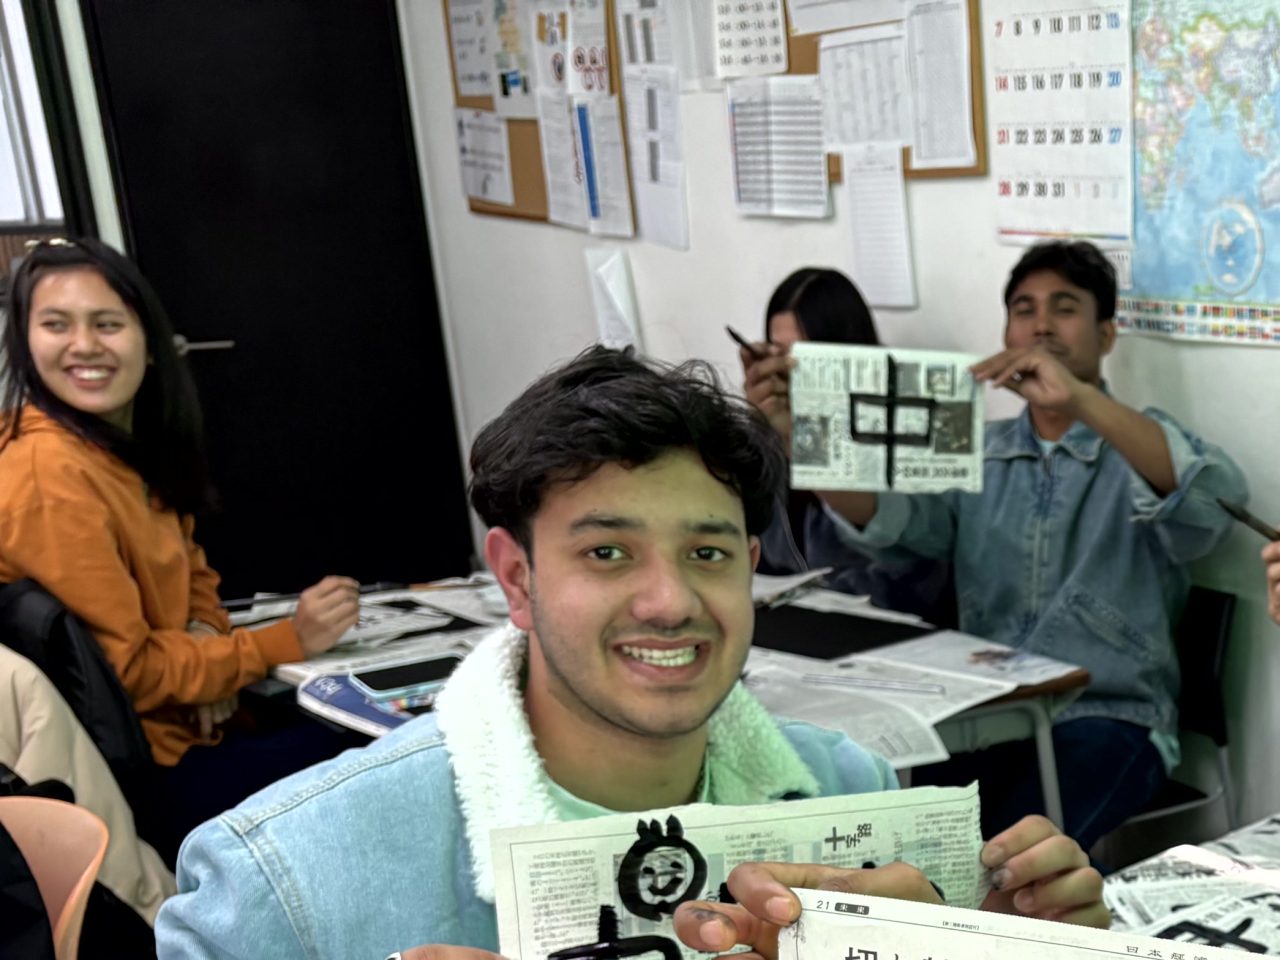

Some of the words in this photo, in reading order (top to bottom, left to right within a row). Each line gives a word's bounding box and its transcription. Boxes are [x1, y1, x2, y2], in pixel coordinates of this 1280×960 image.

[995, 21, 1004, 37] 7
[1049, 16, 1063, 33] 10
[1088, 14, 1101, 31] 12
[1014, 75, 1027, 91] 15
[1032, 74, 1045, 90] 16
[1050, 73, 1064, 90] 17
[1069, 72, 1083, 89] 18
[1015, 129, 1029, 144] 22
[1033, 128, 1047, 144] 23
[1051, 128, 1066, 144] 24
[1070, 128, 1084, 144] 25
[1109, 127, 1122, 144] 27
[1034, 181, 1048, 197] 30
[1052, 182, 1066, 197] 31
[849, 353, 936, 489] 中
[816, 900, 830, 911] 21
